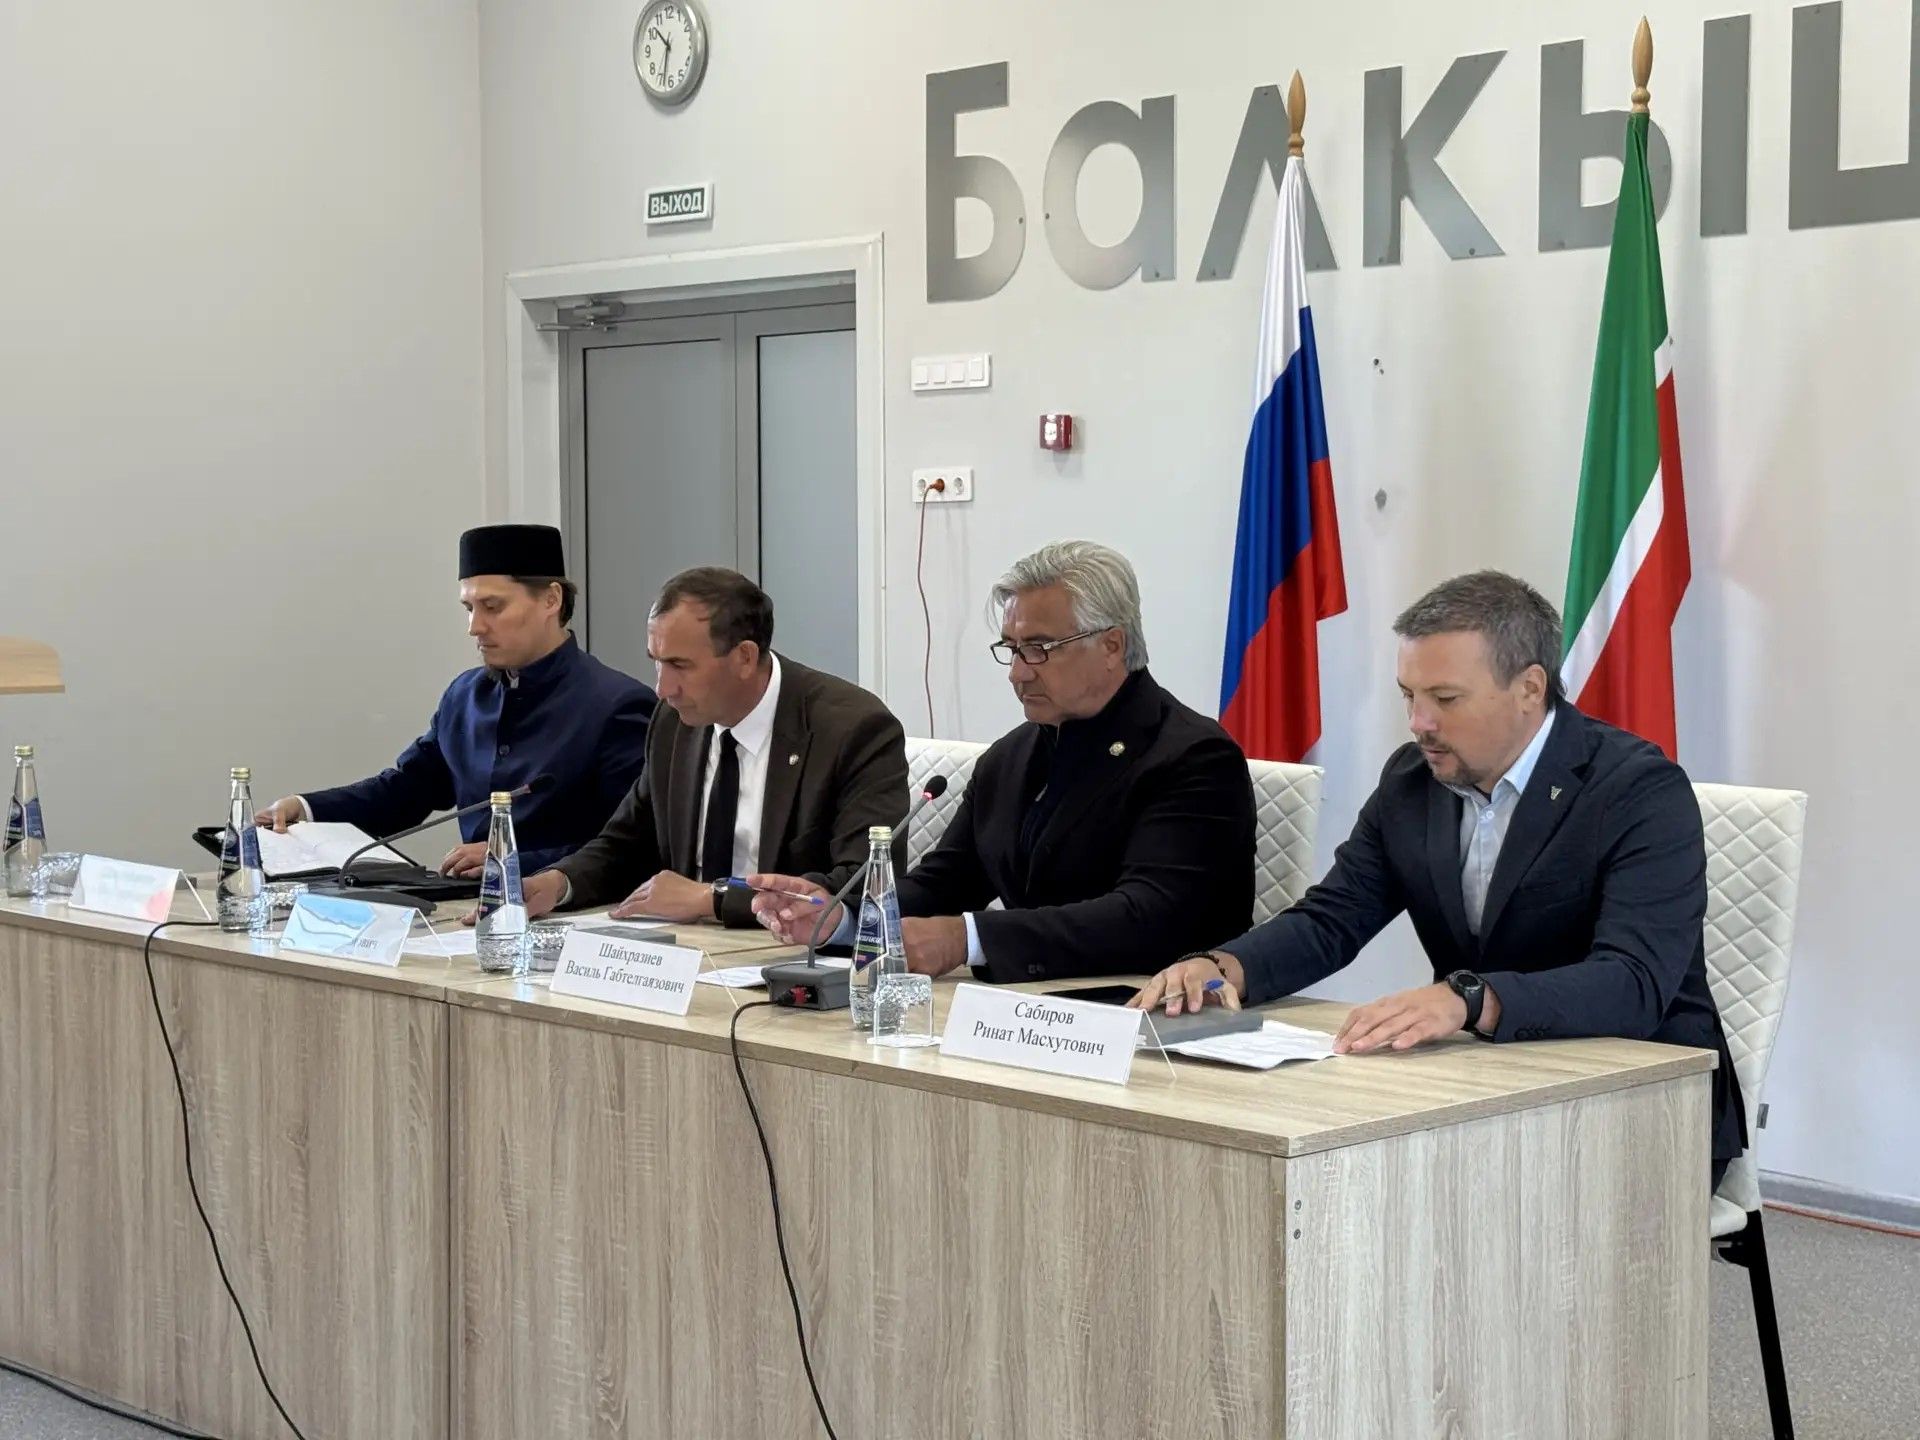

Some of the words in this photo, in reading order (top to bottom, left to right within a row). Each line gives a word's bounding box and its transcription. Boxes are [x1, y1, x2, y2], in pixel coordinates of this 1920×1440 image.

[664, 5, 674, 19] 12
[655, 13, 663, 26] 11
[648, 27, 658, 40] 10
[645, 45, 651, 58] 9
[649, 62, 656, 75] 8
[678, 69, 684, 81] 5
[657, 73, 663, 86] 7
[668, 75, 674, 88] 6
[650, 192, 702, 216] ВЫХОД
[565, 960, 601, 979] Василь
[1014, 1002, 1074, 1026] Сабиров
[973, 1020, 1015, 1042] Ринат
[1017, 1027, 1105, 1057] Масхутович
